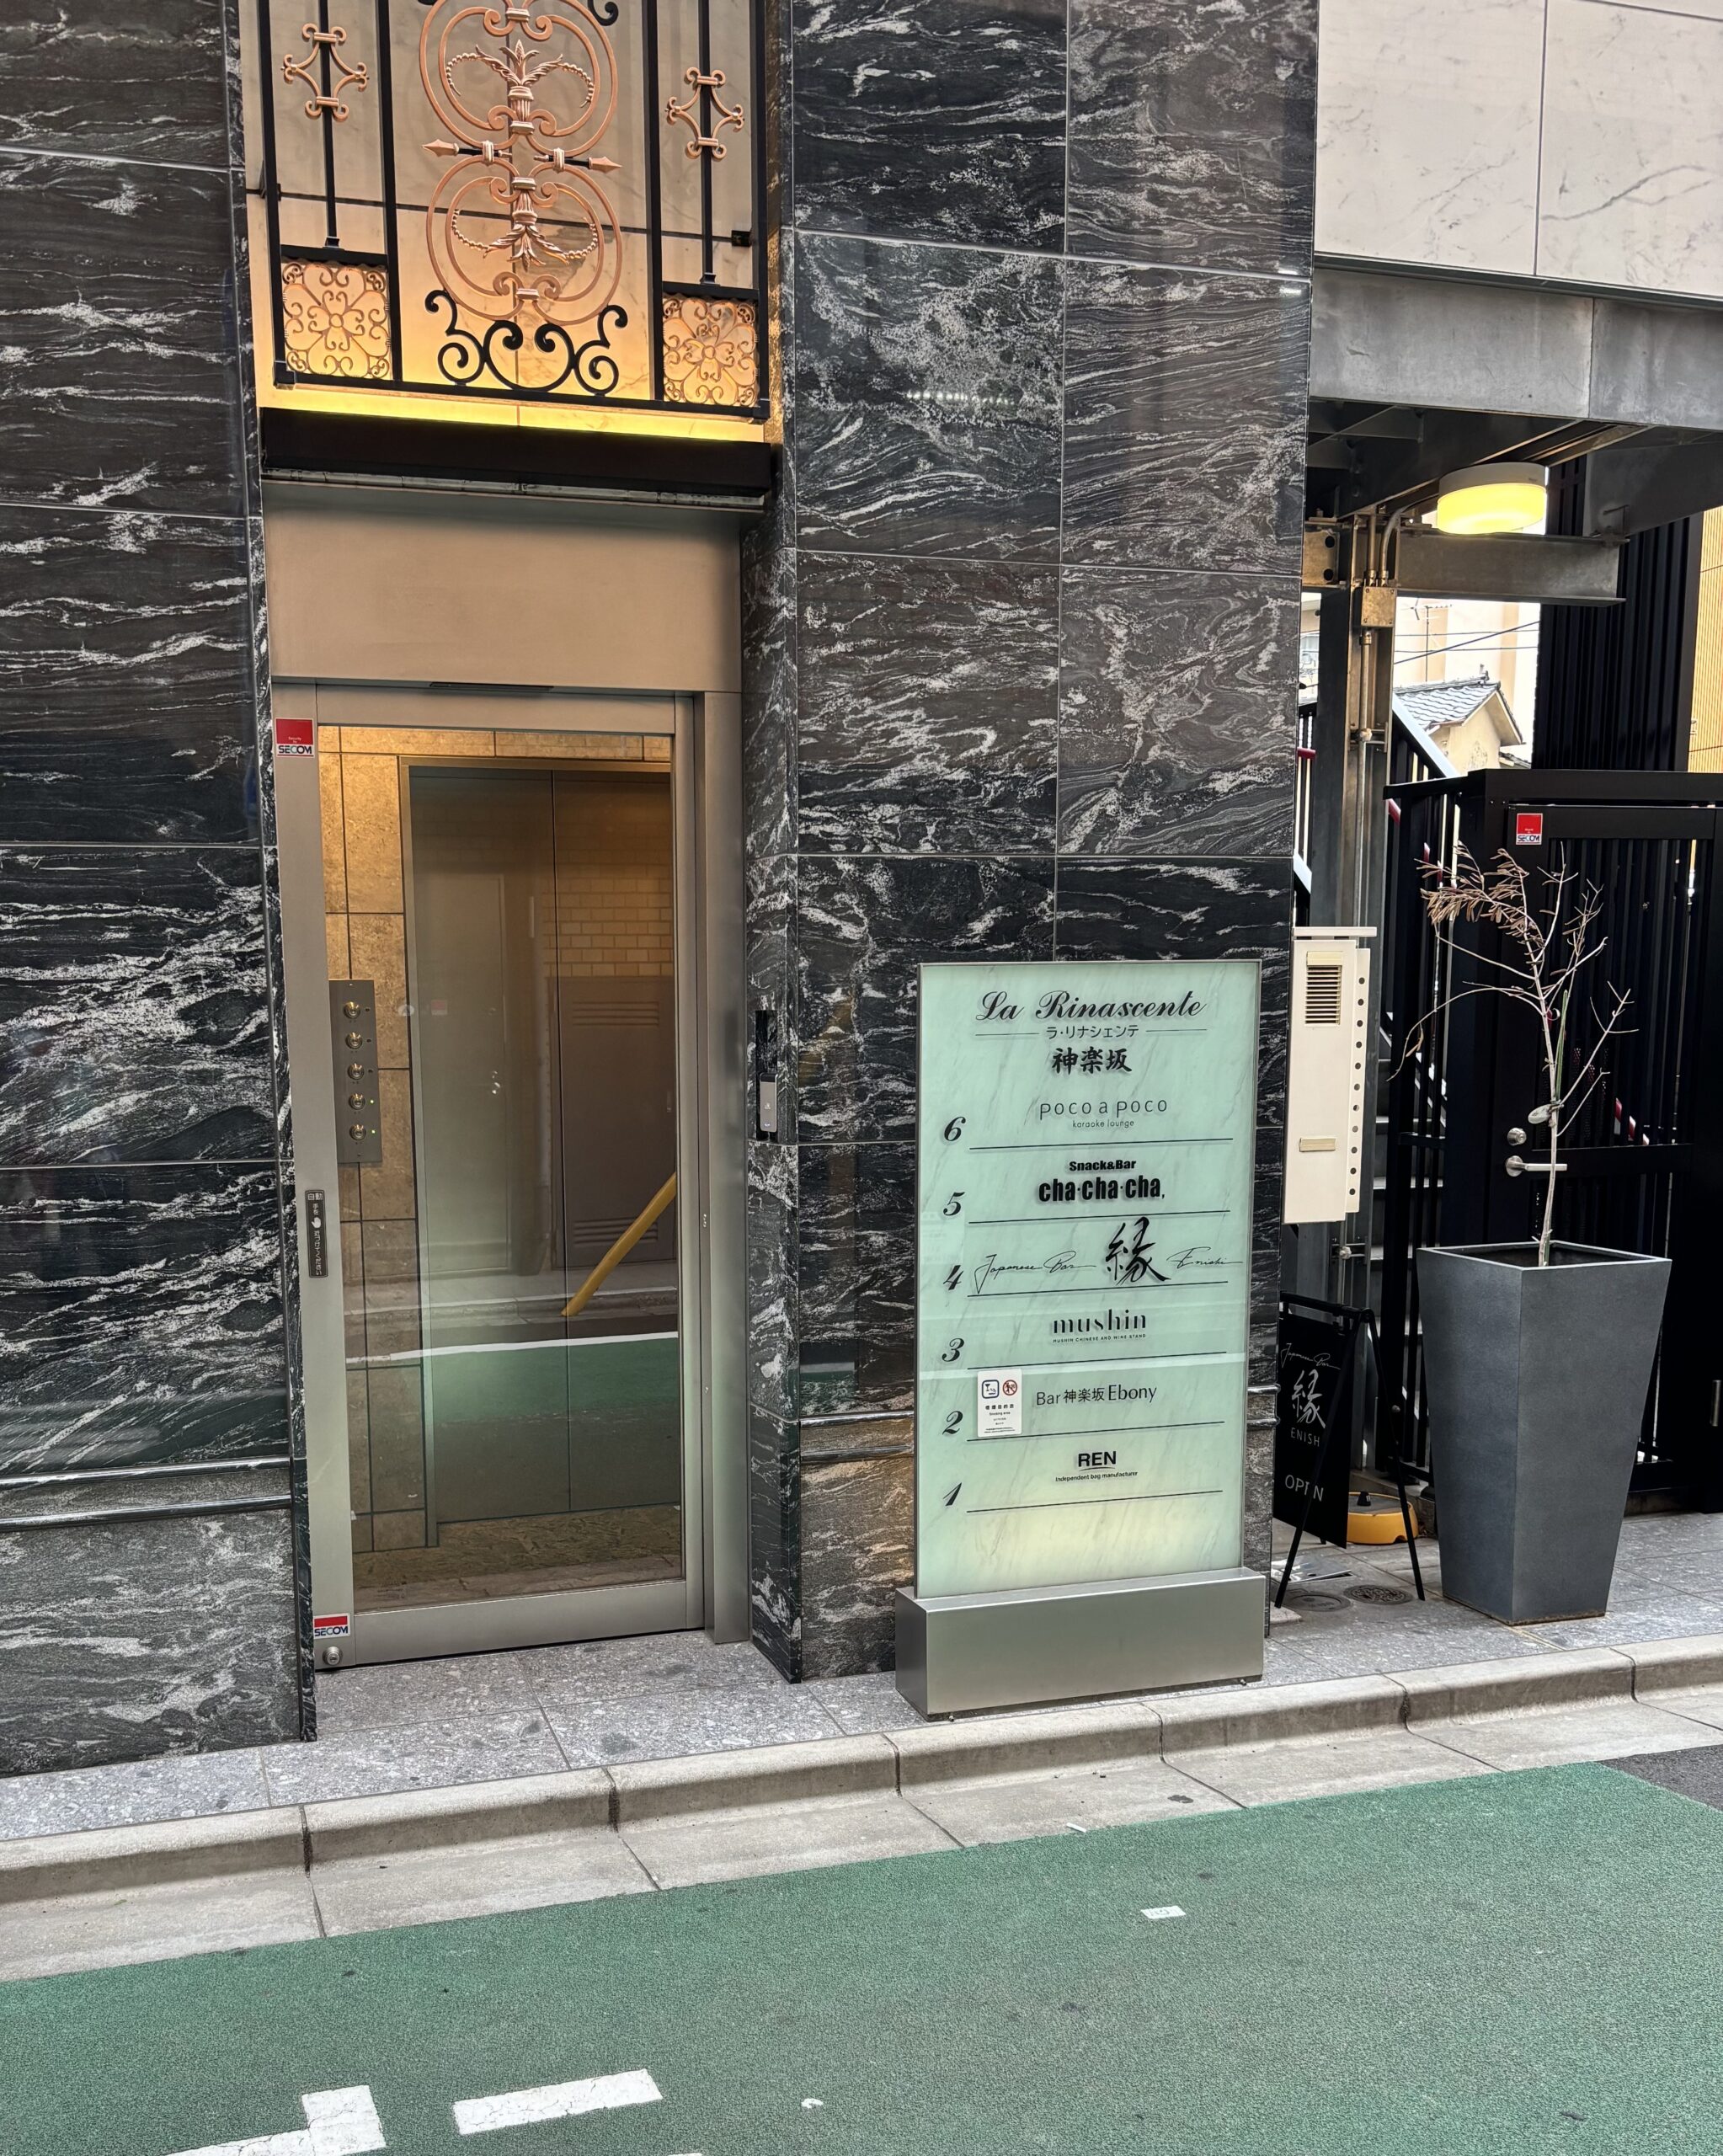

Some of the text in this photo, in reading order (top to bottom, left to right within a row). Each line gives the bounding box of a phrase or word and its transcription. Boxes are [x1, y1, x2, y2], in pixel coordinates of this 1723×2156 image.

[279, 745, 312, 755] SECOM
[976, 990, 1207, 1021] La Rinascente
[1052, 1046, 1133, 1075] 神楽坂
[1040, 1099, 1167, 1121] poco a poco
[944, 1116, 966, 1141] 6
[1073, 1119, 1134, 1129] karaoke lounge
[1069, 1160, 1136, 1171] Snack&Bar
[943, 1192, 966, 1216] 5
[974, 1254, 1043, 1294] Japanese
[1043, 1250, 1097, 1273] Bar
[1106, 1216, 1171, 1285] 縁
[942, 1264, 964, 1290] 4
[1054, 1309, 1146, 1333] mushin
[942, 1337, 965, 1362] 3
[1291, 1369, 1326, 1429] 縁
[942, 1410, 963, 1435] 2
[1290, 1427, 1320, 1447] ENISH
[1078, 1450, 1117, 1467] REN
[942, 1482, 963, 1507] 1
[314, 1625, 349, 1637] SECOM
